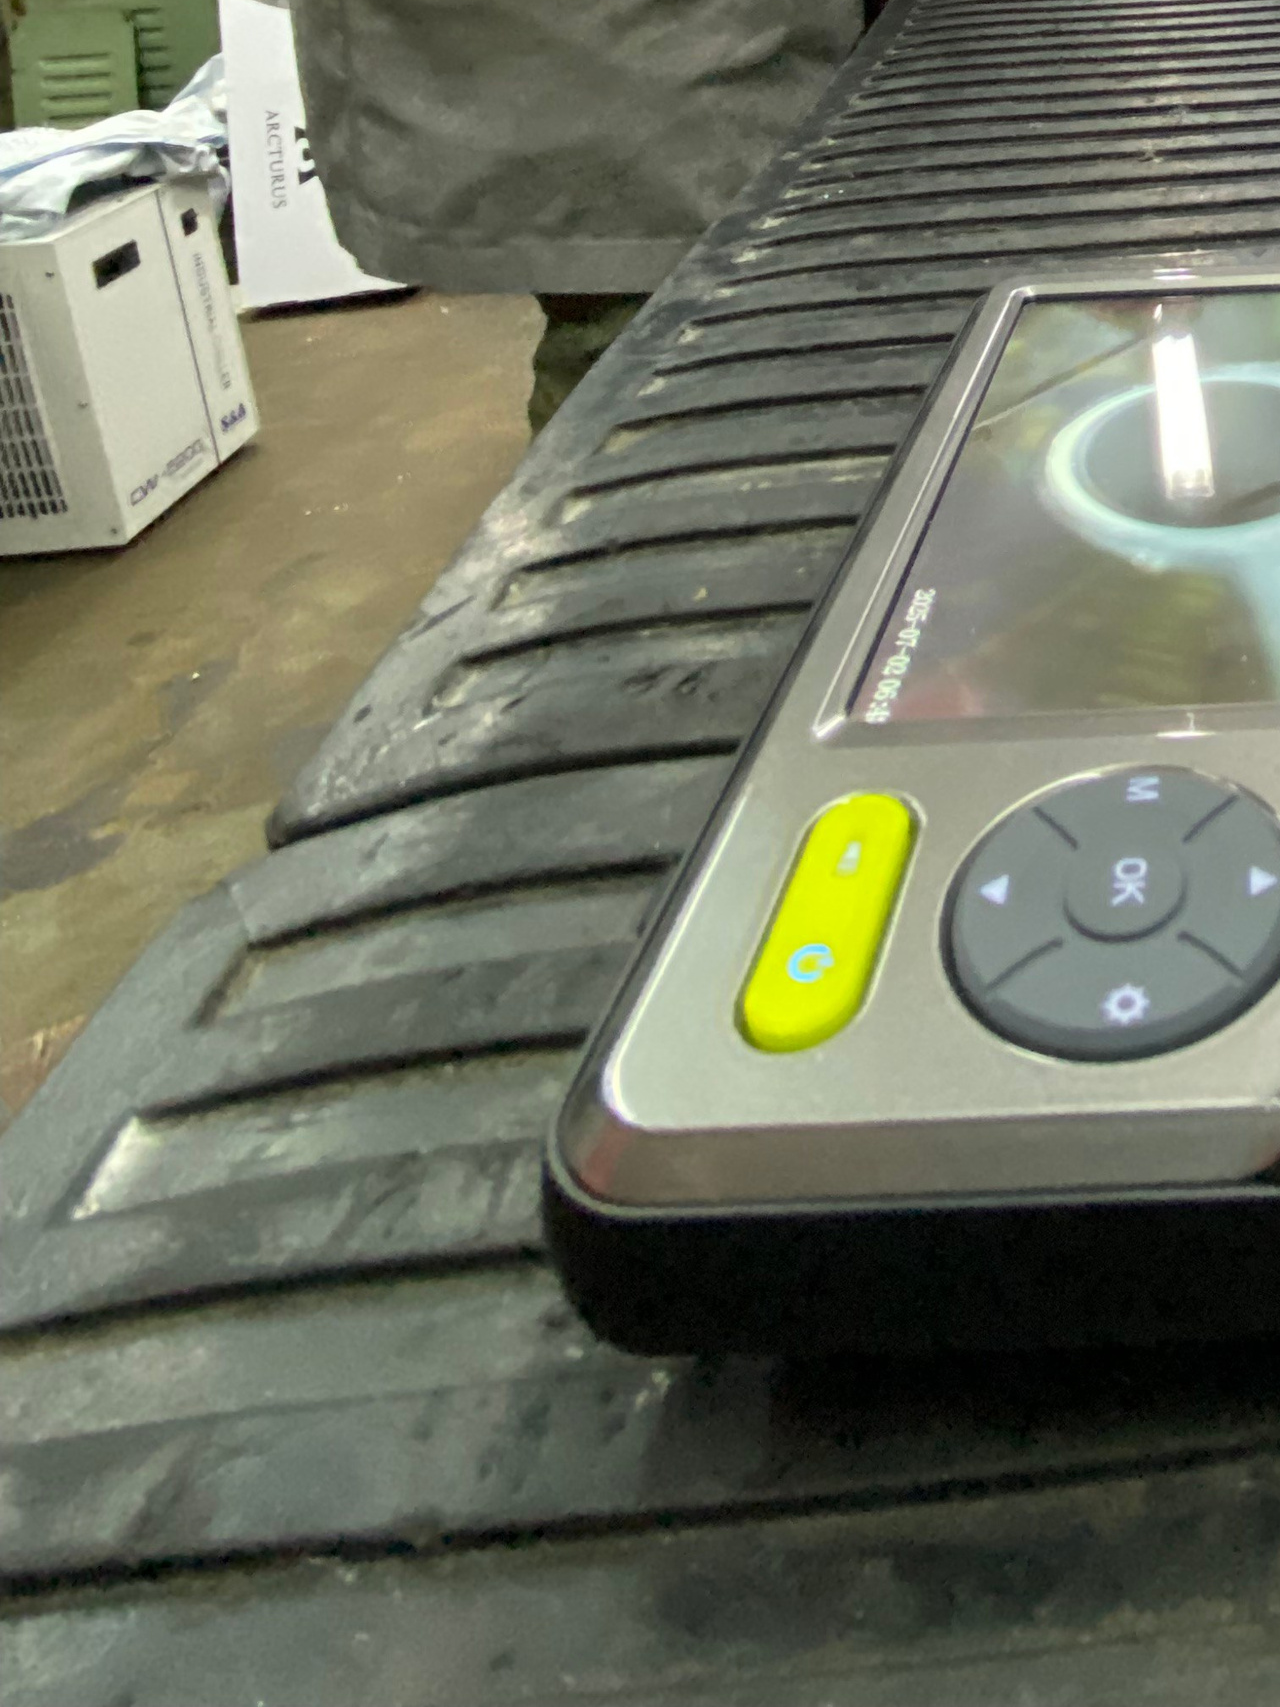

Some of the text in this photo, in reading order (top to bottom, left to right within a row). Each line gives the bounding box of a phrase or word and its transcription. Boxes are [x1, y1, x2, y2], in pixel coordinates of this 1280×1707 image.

[265, 109, 288, 210] ARCTURUS
[882, 587, 937, 676] 2025-07-02
[1126, 775, 1160, 802] M
[1110, 856, 1149, 908] OK
